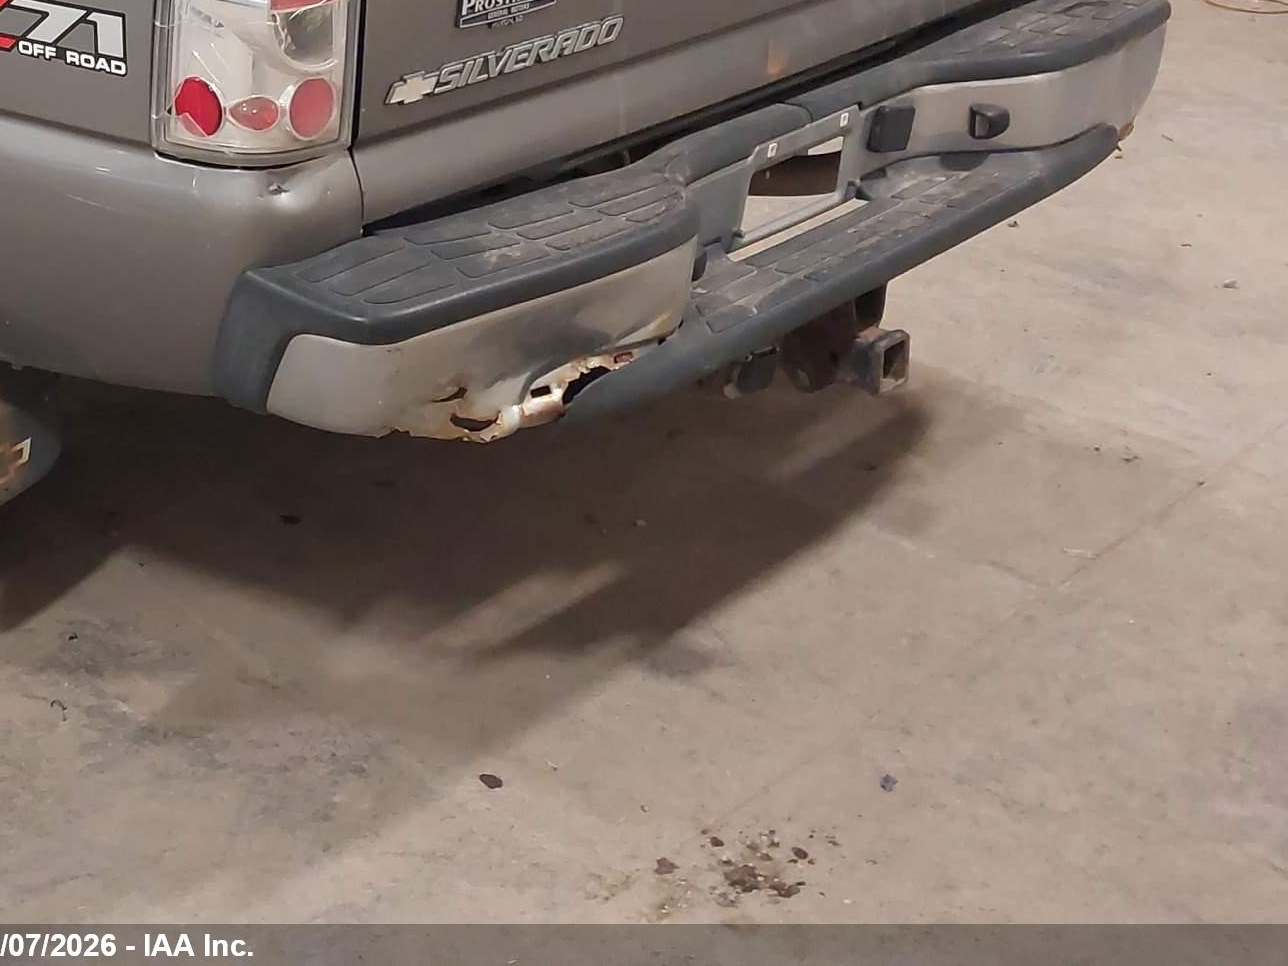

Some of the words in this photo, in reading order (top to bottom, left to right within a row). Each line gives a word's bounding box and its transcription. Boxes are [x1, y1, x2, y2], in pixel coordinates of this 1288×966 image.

[17, 40, 57, 61] OFF
[66, 50, 127, 76] ROAD
[433, 13, 625, 95] SILVERADO
